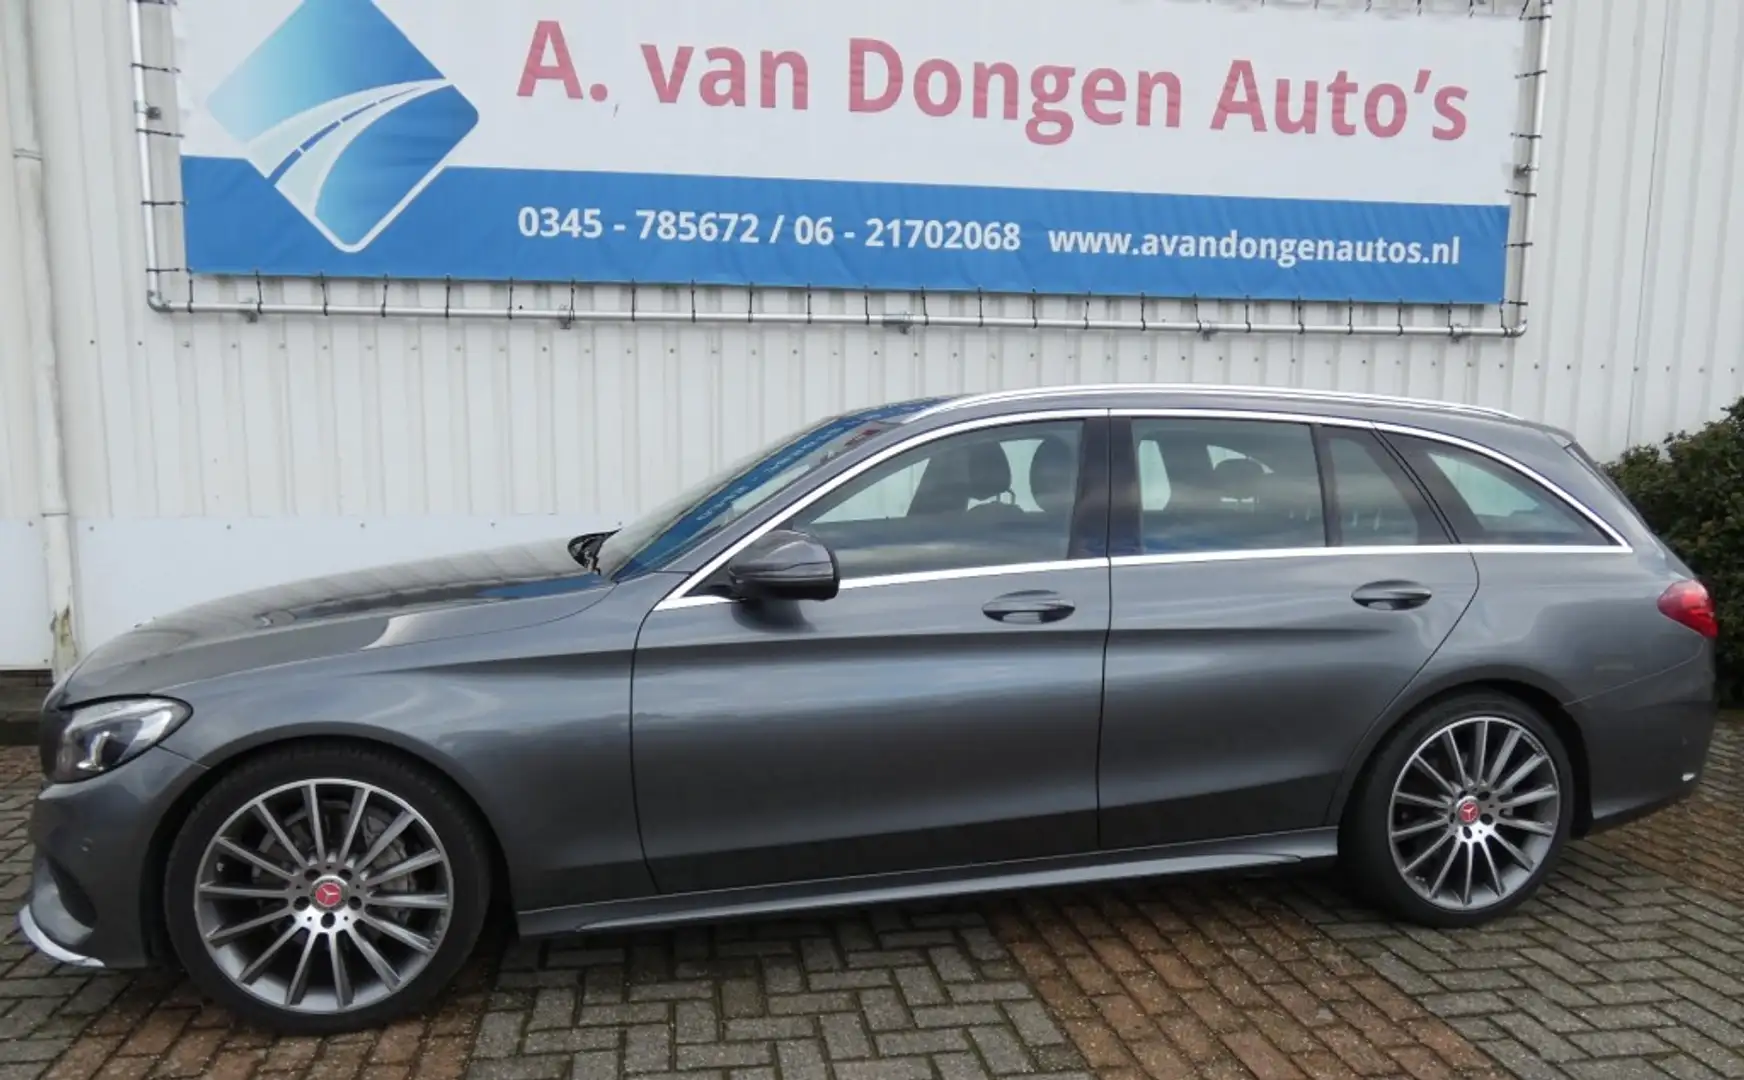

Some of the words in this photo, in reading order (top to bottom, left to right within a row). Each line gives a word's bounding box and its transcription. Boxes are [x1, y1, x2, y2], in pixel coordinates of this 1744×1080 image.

[517, 20, 608, 101] A.
[641, 43, 809, 111] van
[848, 38, 1182, 145] Dongen
[1210, 59, 1469, 141] Auto's
[517, 206, 603, 238] 0345
[635, 210, 759, 243] 785672
[769, 215, 785, 243] /
[794, 215, 834, 245] 06
[864, 218, 1021, 251] 21702068
[1048, 229, 1460, 268] www.avandongenautos.nl
